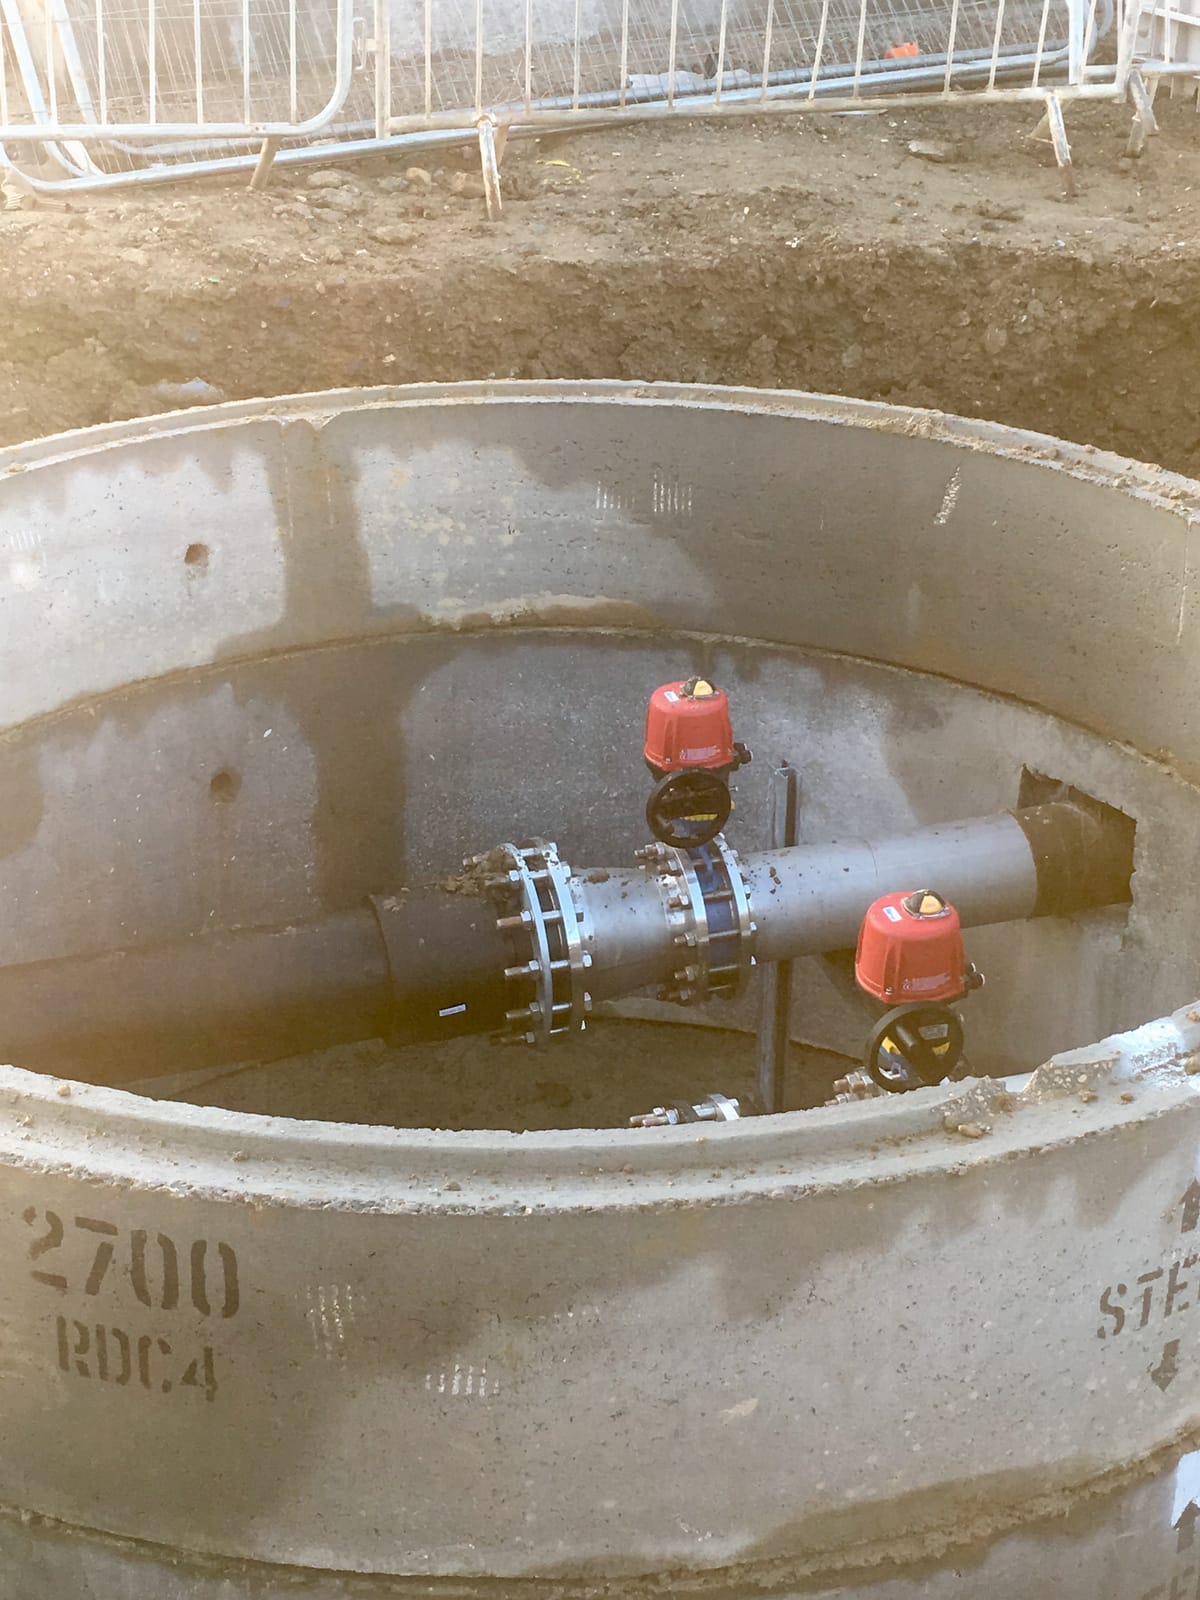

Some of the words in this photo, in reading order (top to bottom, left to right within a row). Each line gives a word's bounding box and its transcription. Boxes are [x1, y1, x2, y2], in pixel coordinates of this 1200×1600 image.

[22, 1205, 240, 1319] 2700
[1097, 1252, 1200, 1340] STE
[56, 1315, 219, 1402] RDC4
